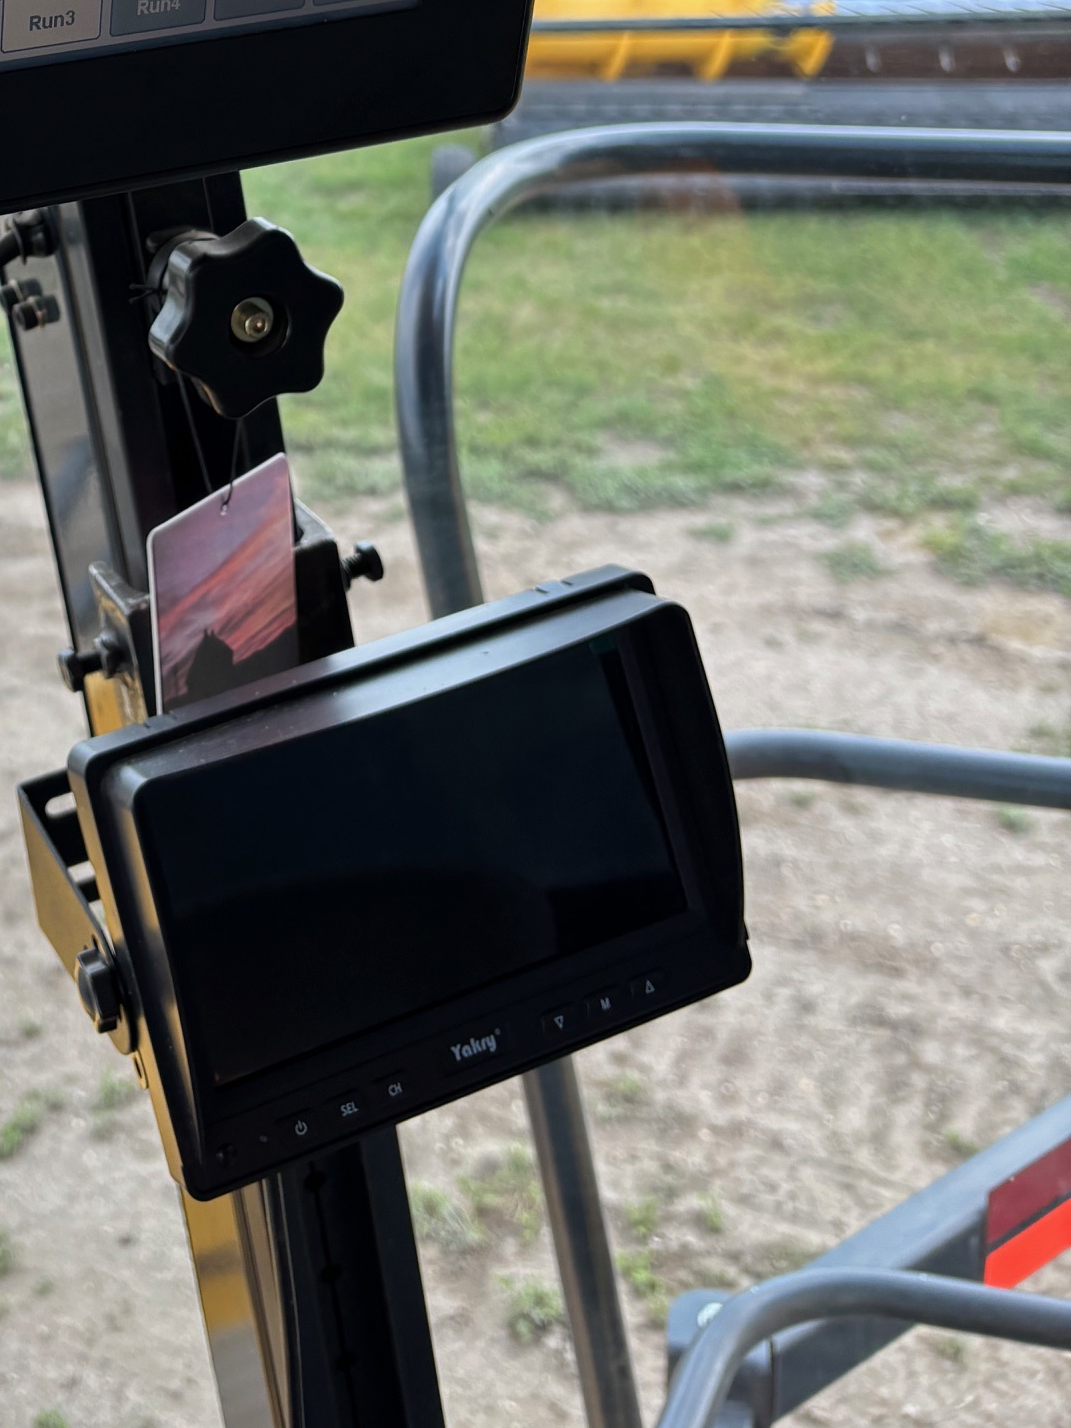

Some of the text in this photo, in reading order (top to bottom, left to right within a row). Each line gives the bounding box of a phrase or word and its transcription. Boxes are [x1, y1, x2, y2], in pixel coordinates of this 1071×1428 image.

[29, 10, 75, 31] Run3
[388, 1082, 402, 1097] CH
[340, 1101, 359, 1117] SEL
